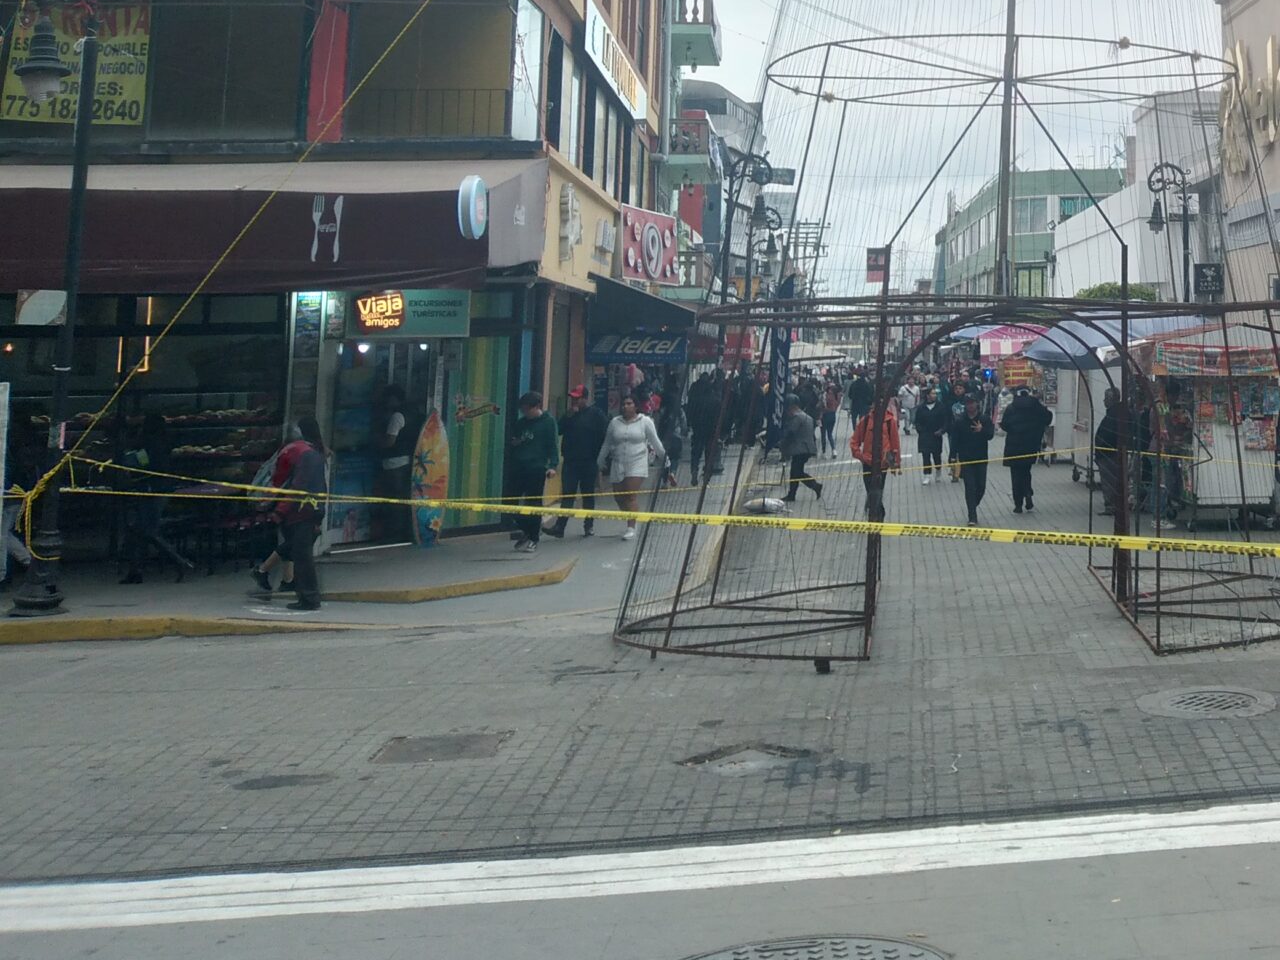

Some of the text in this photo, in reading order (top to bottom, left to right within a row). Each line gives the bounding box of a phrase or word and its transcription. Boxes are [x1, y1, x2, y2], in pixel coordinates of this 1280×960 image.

[98, 62, 146, 75] NEGOCIO
[6, 95, 40, 117] 775
[357, 294, 403, 317] Viaja
[408, 300, 463, 308] EXCURSIONES
[365, 318, 400, 329] amigos
[616, 336, 681, 355] telcel
